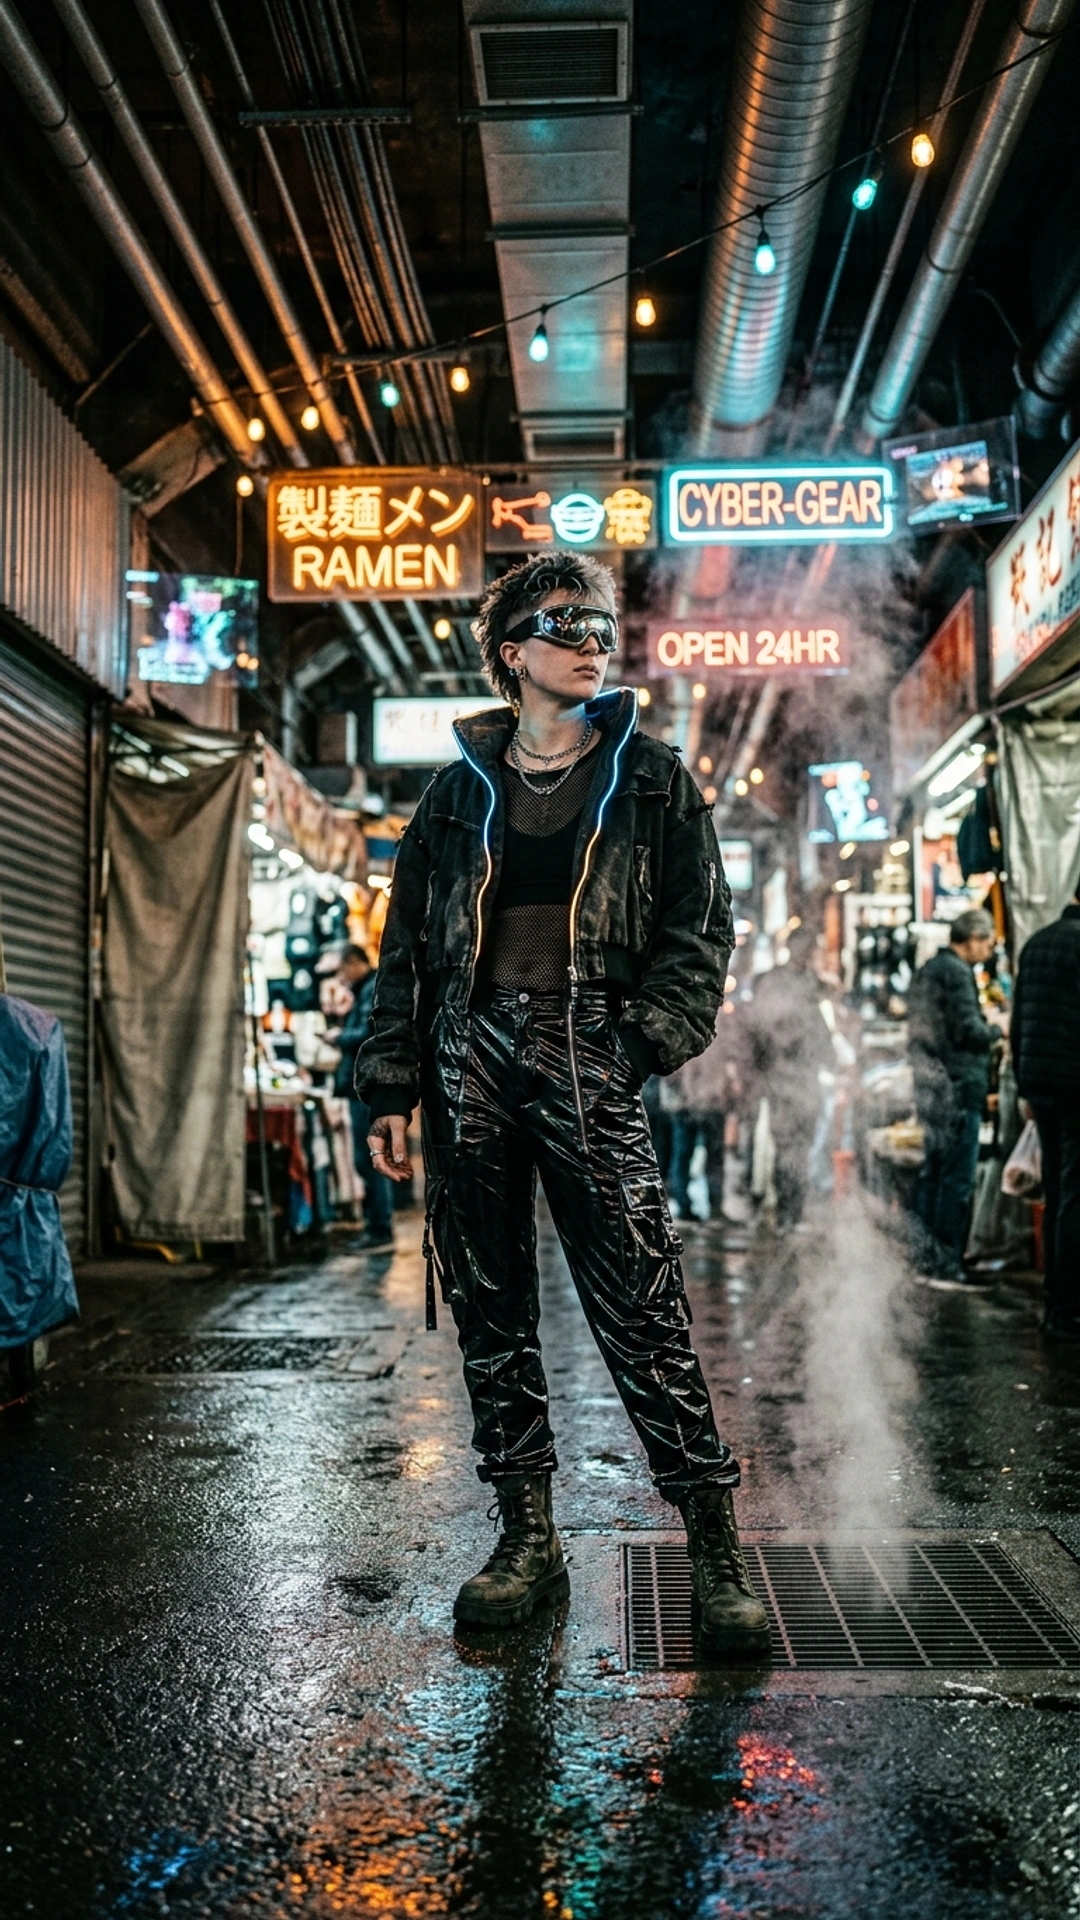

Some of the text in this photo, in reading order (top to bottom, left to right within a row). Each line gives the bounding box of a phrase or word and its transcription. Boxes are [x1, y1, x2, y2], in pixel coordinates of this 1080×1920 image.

[678, 479, 883, 527] CYBER-GEAR
[293, 543, 457, 589] RAMEN
[657, 629, 841, 667] OPEN 24HR
